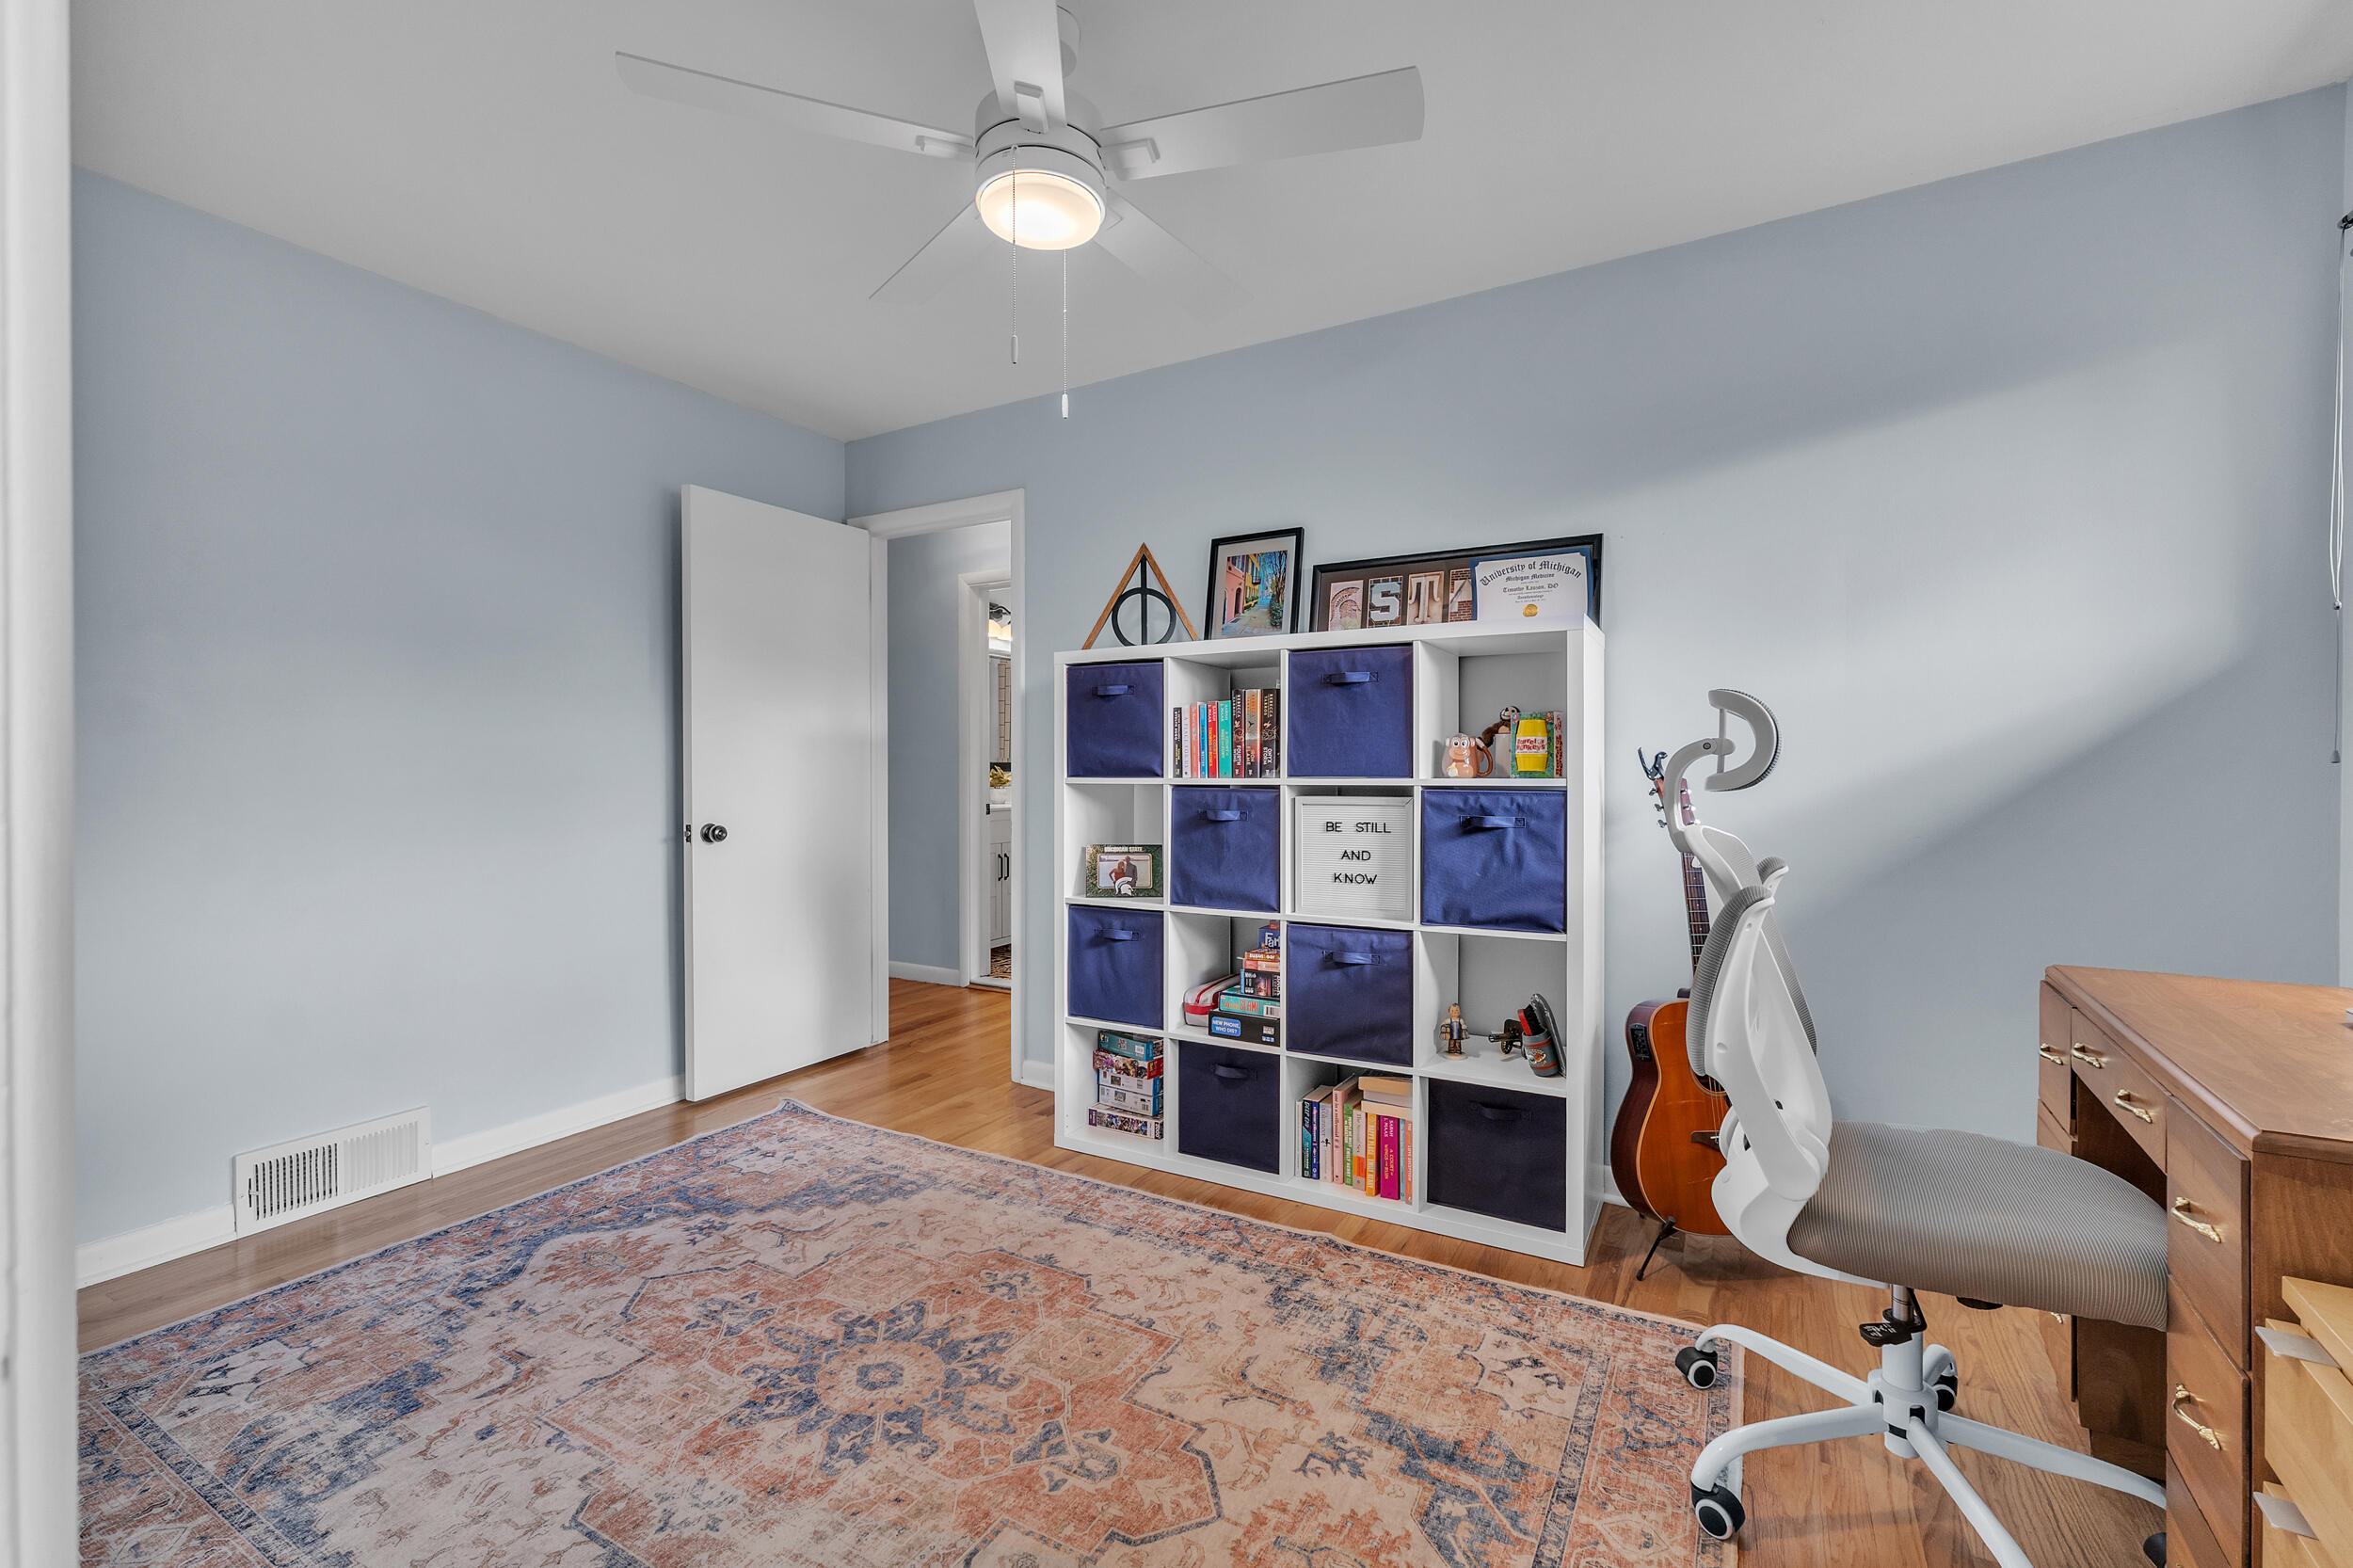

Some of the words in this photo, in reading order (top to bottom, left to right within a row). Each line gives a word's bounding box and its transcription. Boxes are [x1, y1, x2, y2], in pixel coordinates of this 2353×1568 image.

[1480, 564, 1526, 585] University
[1529, 561, 1536, 569] of
[1539, 561, 1581, 578] Michigan
[1326, 822, 1342, 832] BE
[1355, 822, 1391, 833] STILL
[1341, 850, 1371, 860] AND
[1334, 872, 1377, 885] KNOW
